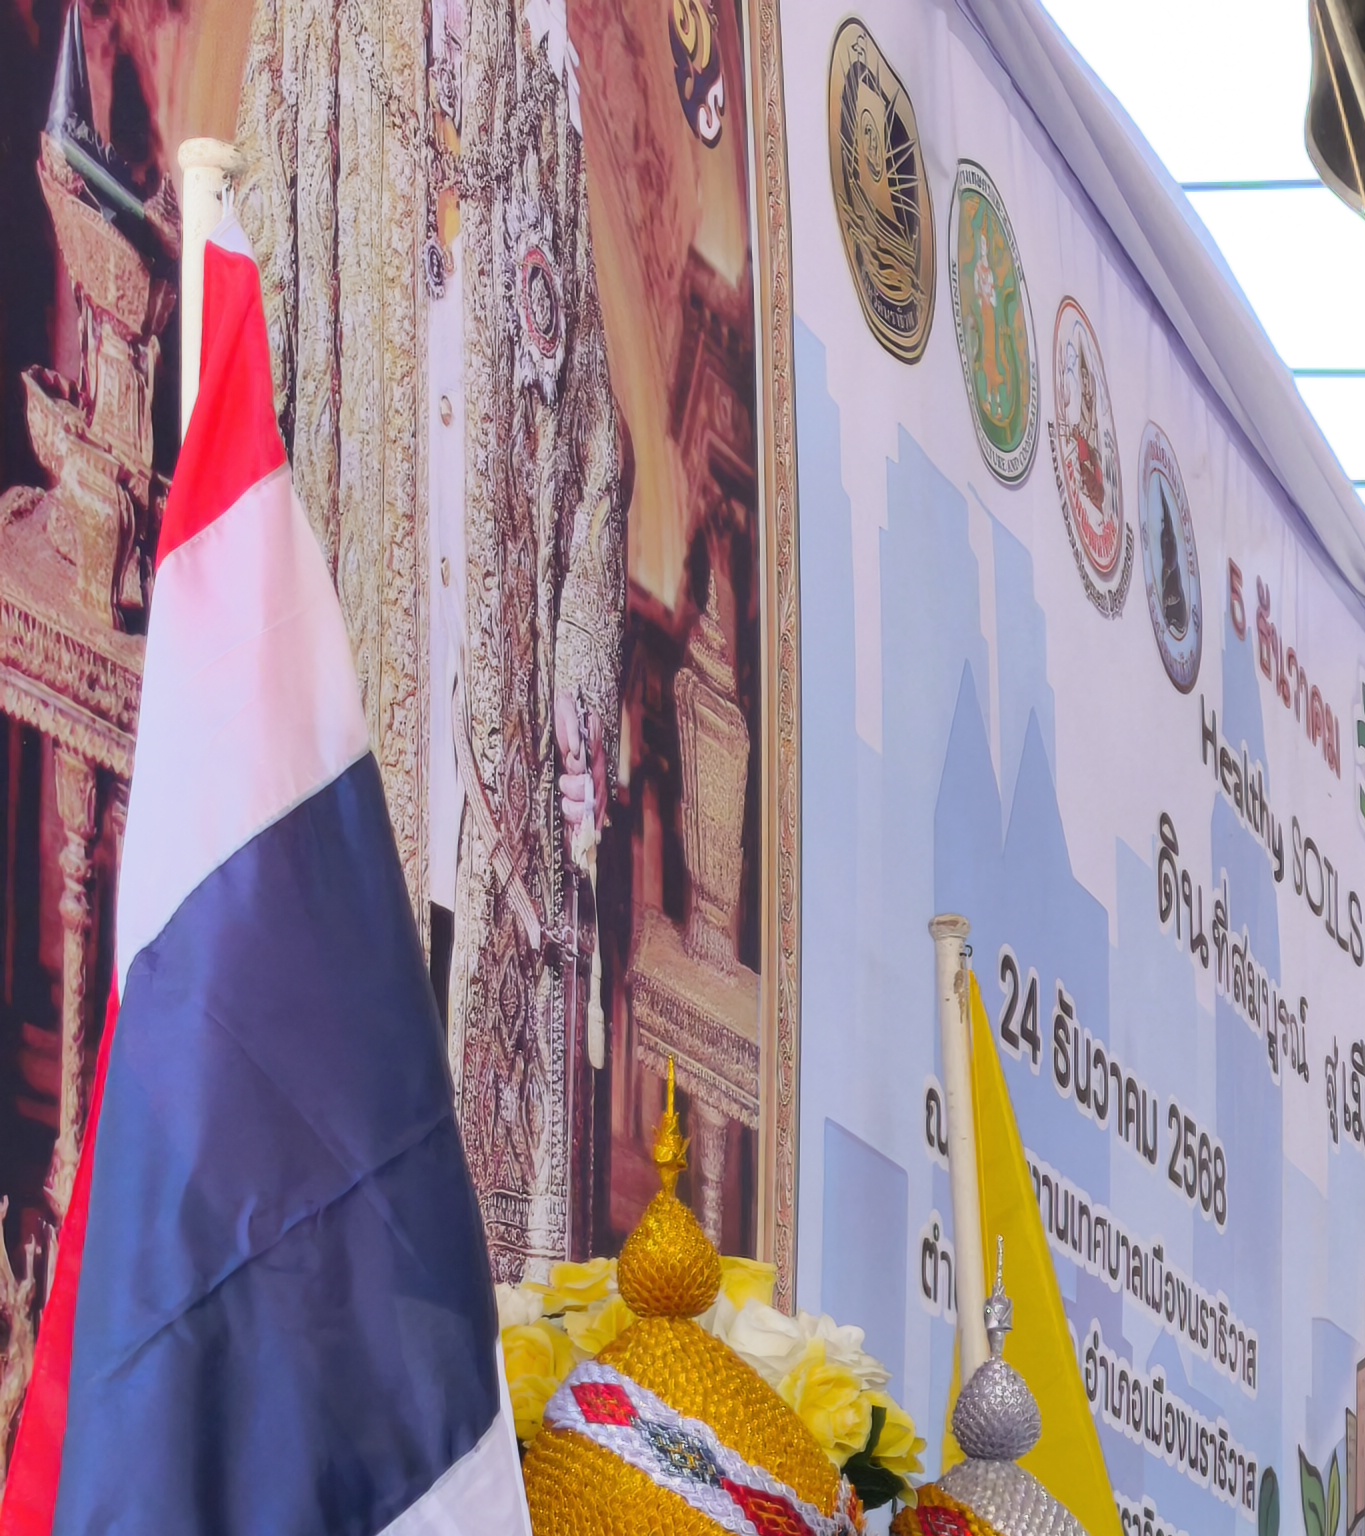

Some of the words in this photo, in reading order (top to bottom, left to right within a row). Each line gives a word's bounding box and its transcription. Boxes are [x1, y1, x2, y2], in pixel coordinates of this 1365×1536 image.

[1229, 556, 1246, 642] 5
[1200, 693, 1285, 883] Healthy
[1291, 815, 1365, 968] SOILS
[1000, 953, 1041, 1065] 24
[1053, 988, 1159, 1166] ธันวาคม
[1167, 1102, 1227, 1227] 2568
